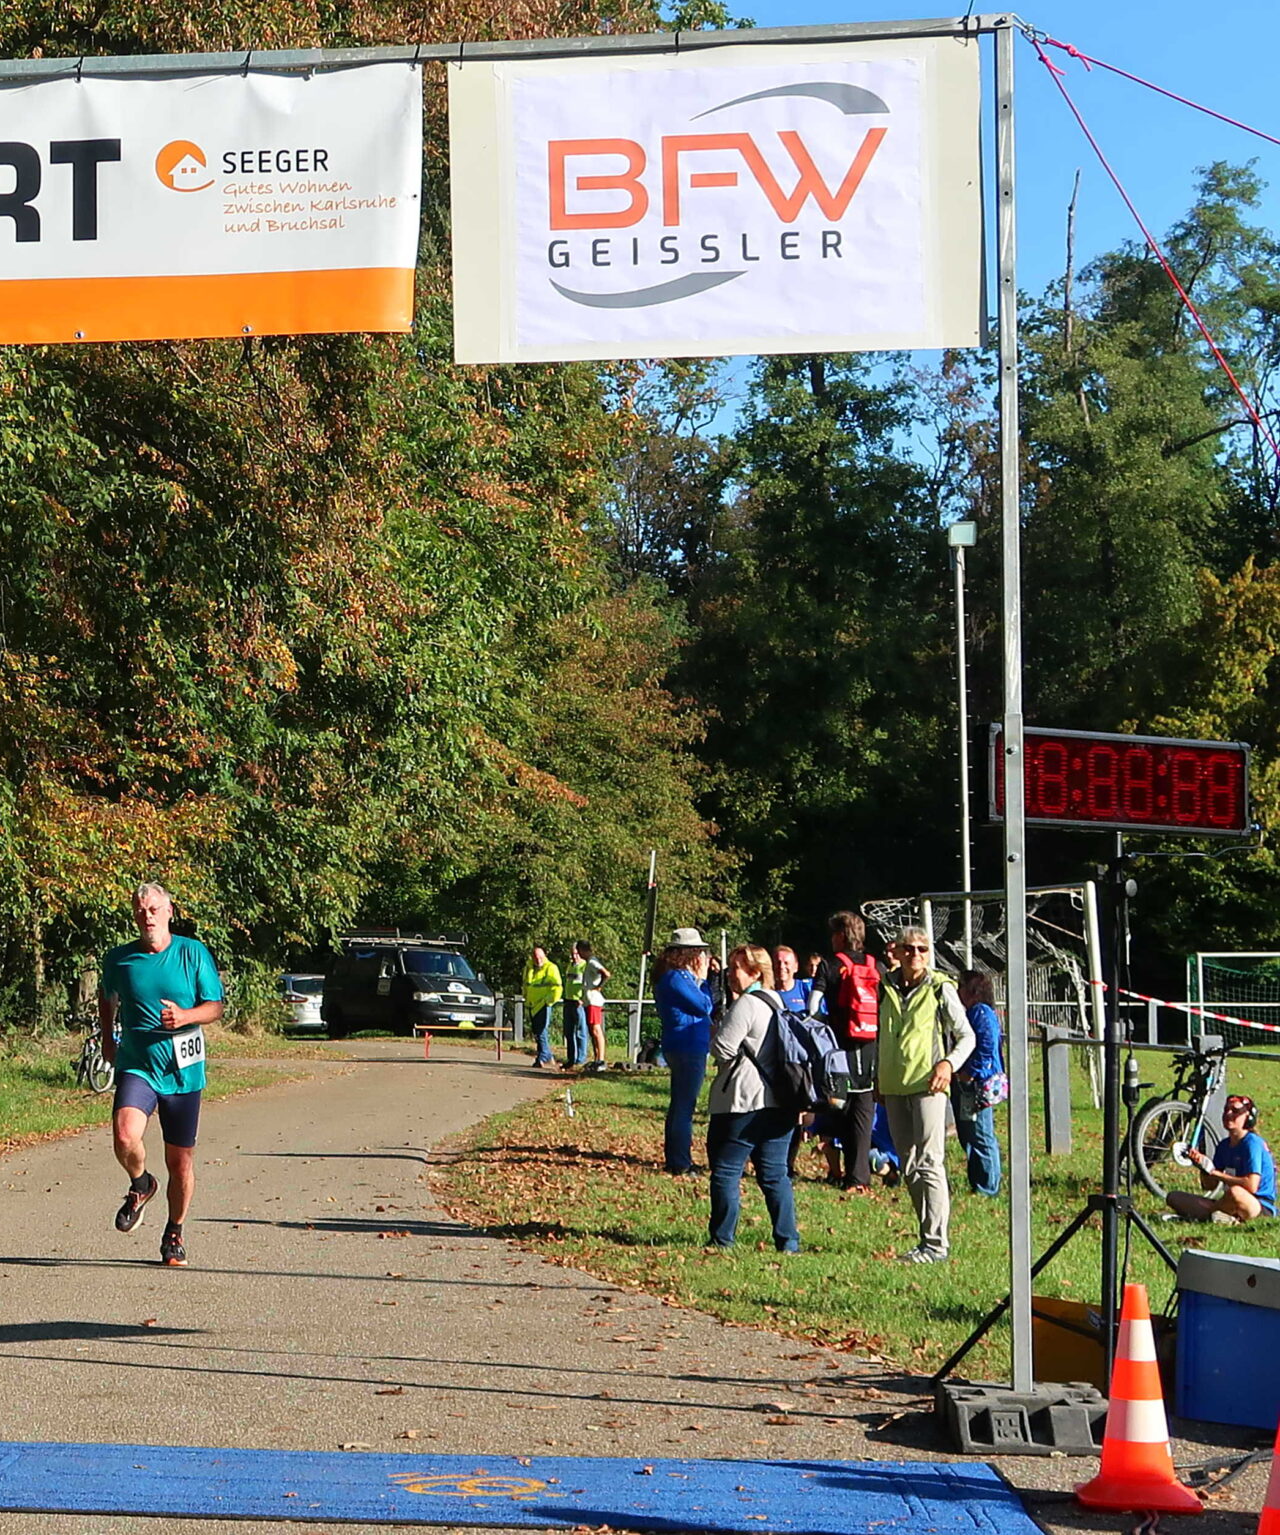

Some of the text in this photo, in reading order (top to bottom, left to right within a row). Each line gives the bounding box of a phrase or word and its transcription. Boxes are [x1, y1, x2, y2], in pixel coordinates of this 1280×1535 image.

[223, 149, 329, 175] SEEGER
[223, 180, 352, 196] Gutes Wohnen
[548, 127, 888, 230] BFW
[223, 195, 397, 214] zwischen Karlsruhe
[224, 215, 345, 233] und Bruchsal
[548, 230, 843, 268] GEISSLER
[180, 1036, 201, 1059] 680
